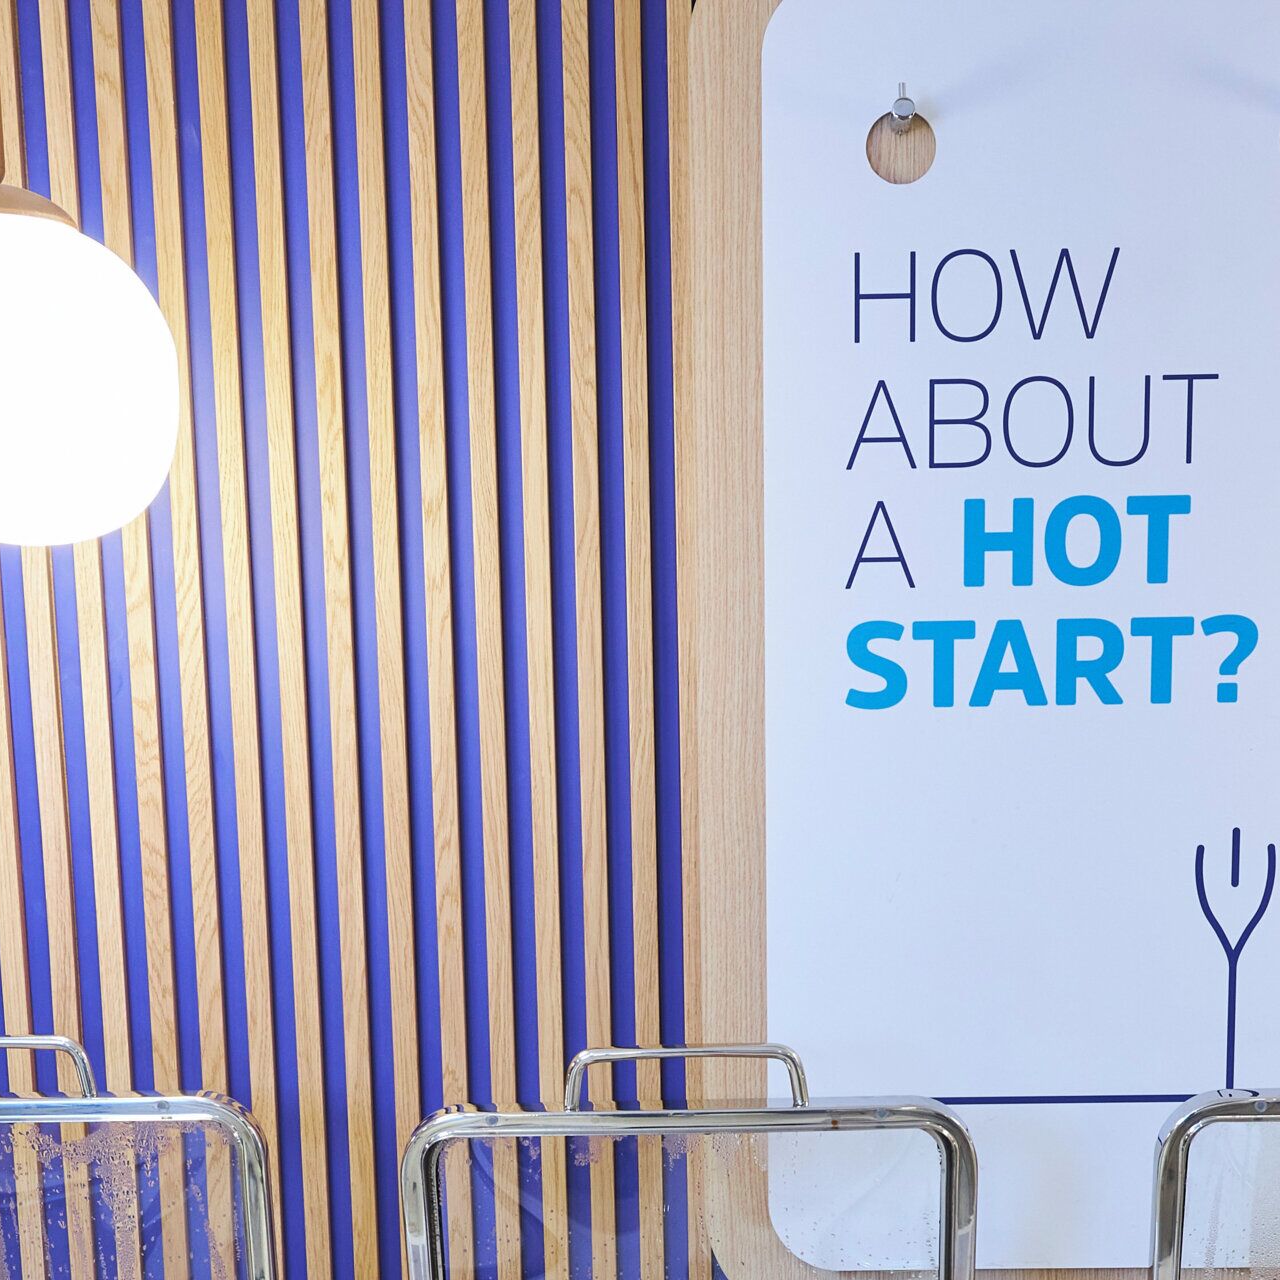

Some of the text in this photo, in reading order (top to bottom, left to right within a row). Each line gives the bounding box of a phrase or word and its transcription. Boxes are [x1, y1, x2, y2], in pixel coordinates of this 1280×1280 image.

[854, 247, 1120, 343] HOW
[846, 373, 1219, 471] ABOUT
[845, 494, 1191, 590] A HOT
[845, 614, 1259, 710] START?
